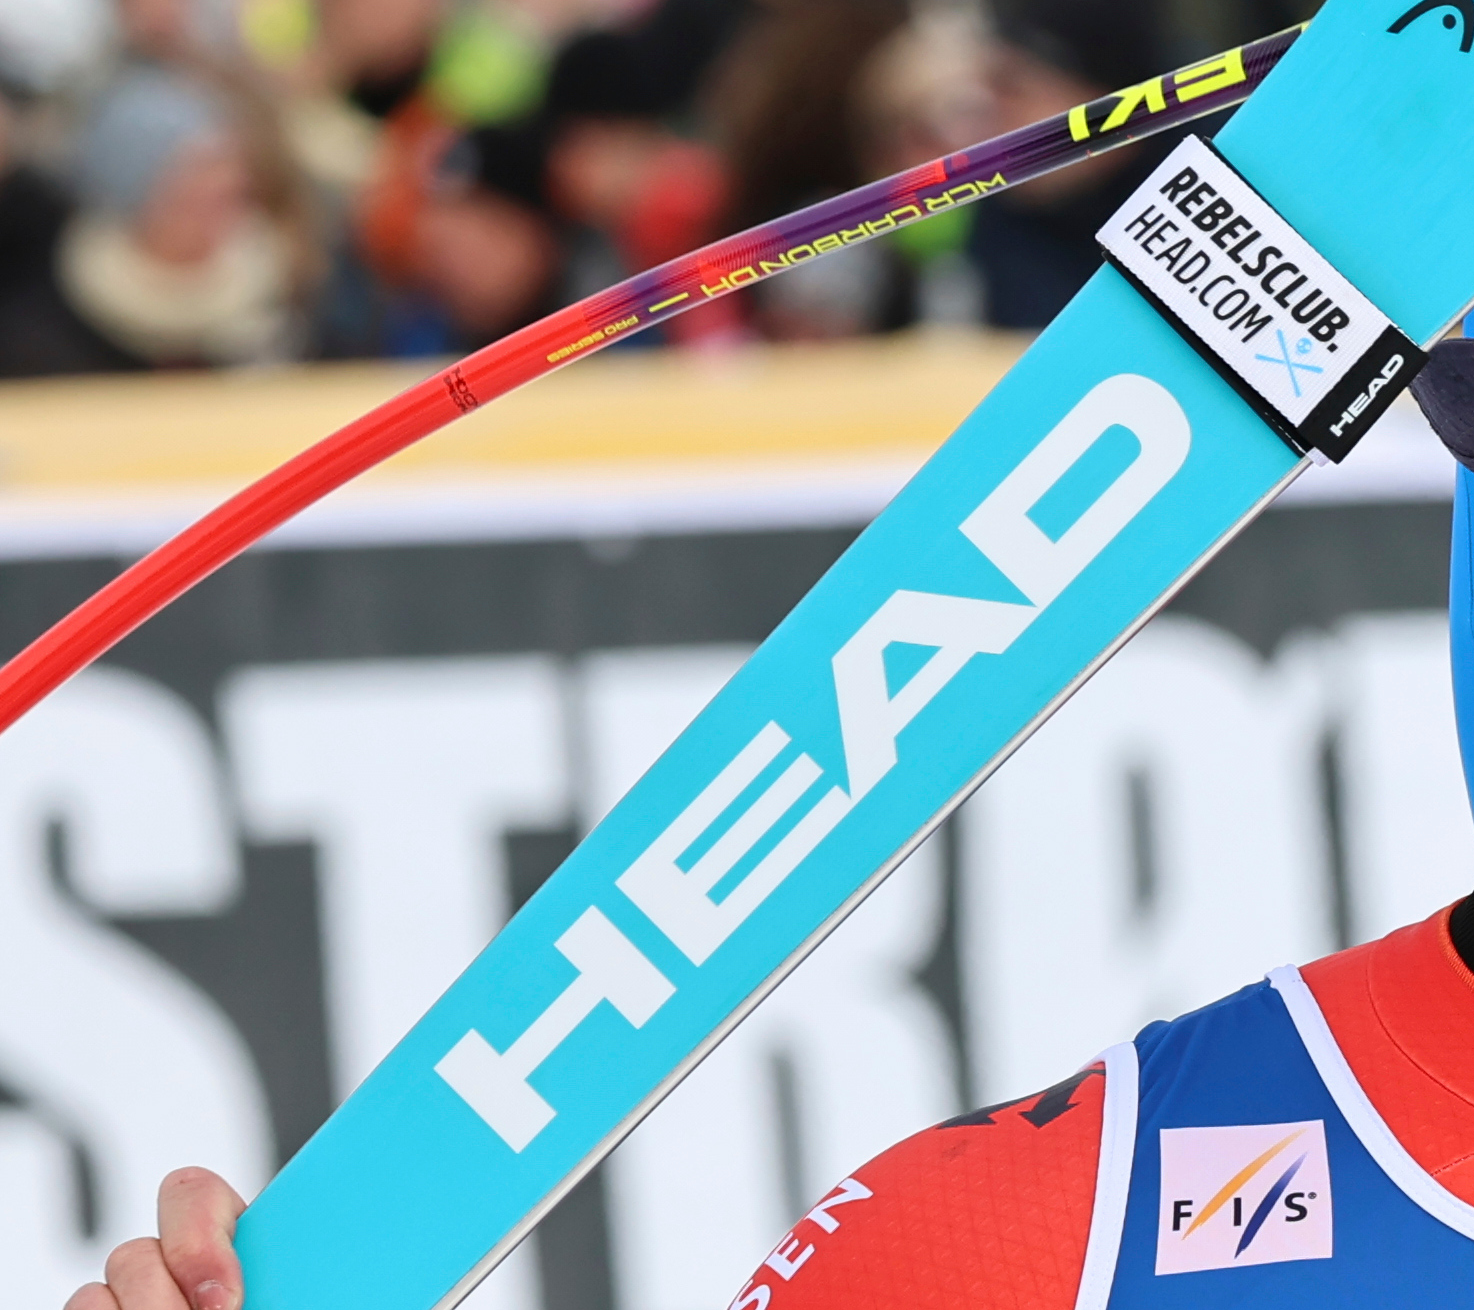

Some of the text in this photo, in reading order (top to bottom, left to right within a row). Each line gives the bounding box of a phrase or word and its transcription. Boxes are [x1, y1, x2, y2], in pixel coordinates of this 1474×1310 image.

[1069, 47, 1247, 142] EKI
[701, 171, 1007, 298] WCR CARBON DH
[1124, 205, 1274, 343] HEAD.COM
[1159, 167, 1351, 353] REBELSCLUB.
[546, 315, 639, 364] PRO SERIES
[1330, 354, 1405, 437] HEAD
[434, 374, 1192, 1153] HEAD
[1171, 1188, 1310, 1236] FIS
